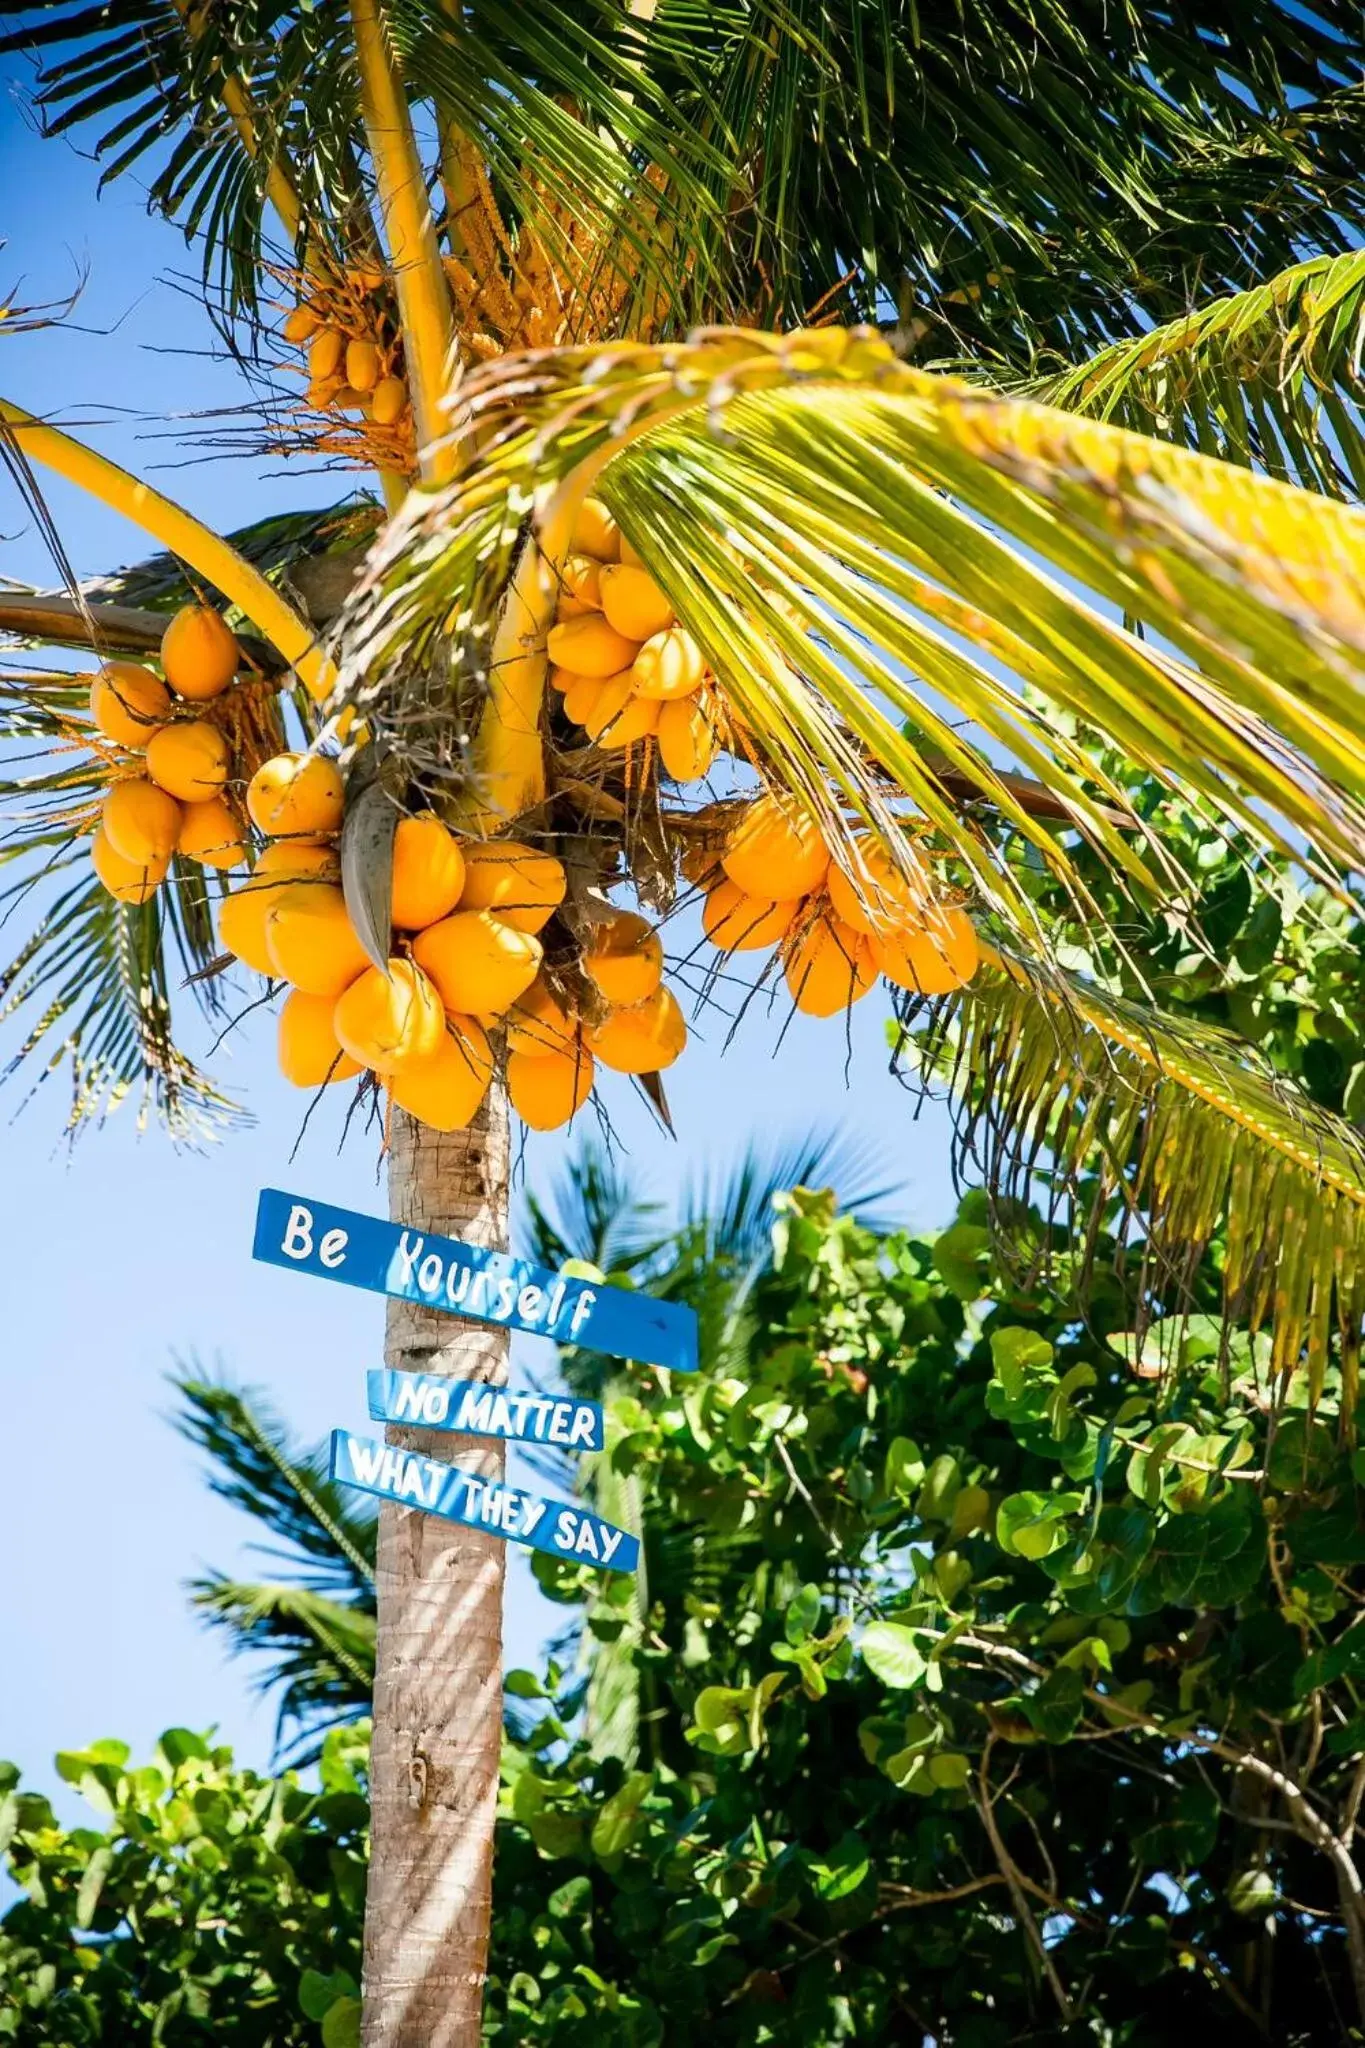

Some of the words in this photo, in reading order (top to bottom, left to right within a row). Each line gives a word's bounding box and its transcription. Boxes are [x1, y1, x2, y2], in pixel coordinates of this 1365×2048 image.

[280, 1205, 349, 1268] Be
[399, 1231, 597, 1333] Yourself
[394, 1380, 447, 1423] NO
[457, 1391, 595, 1448] MATTER
[347, 1438, 443, 1504] WHAT
[463, 1477, 546, 1537] THEY
[554, 1511, 623, 1564] SAY
